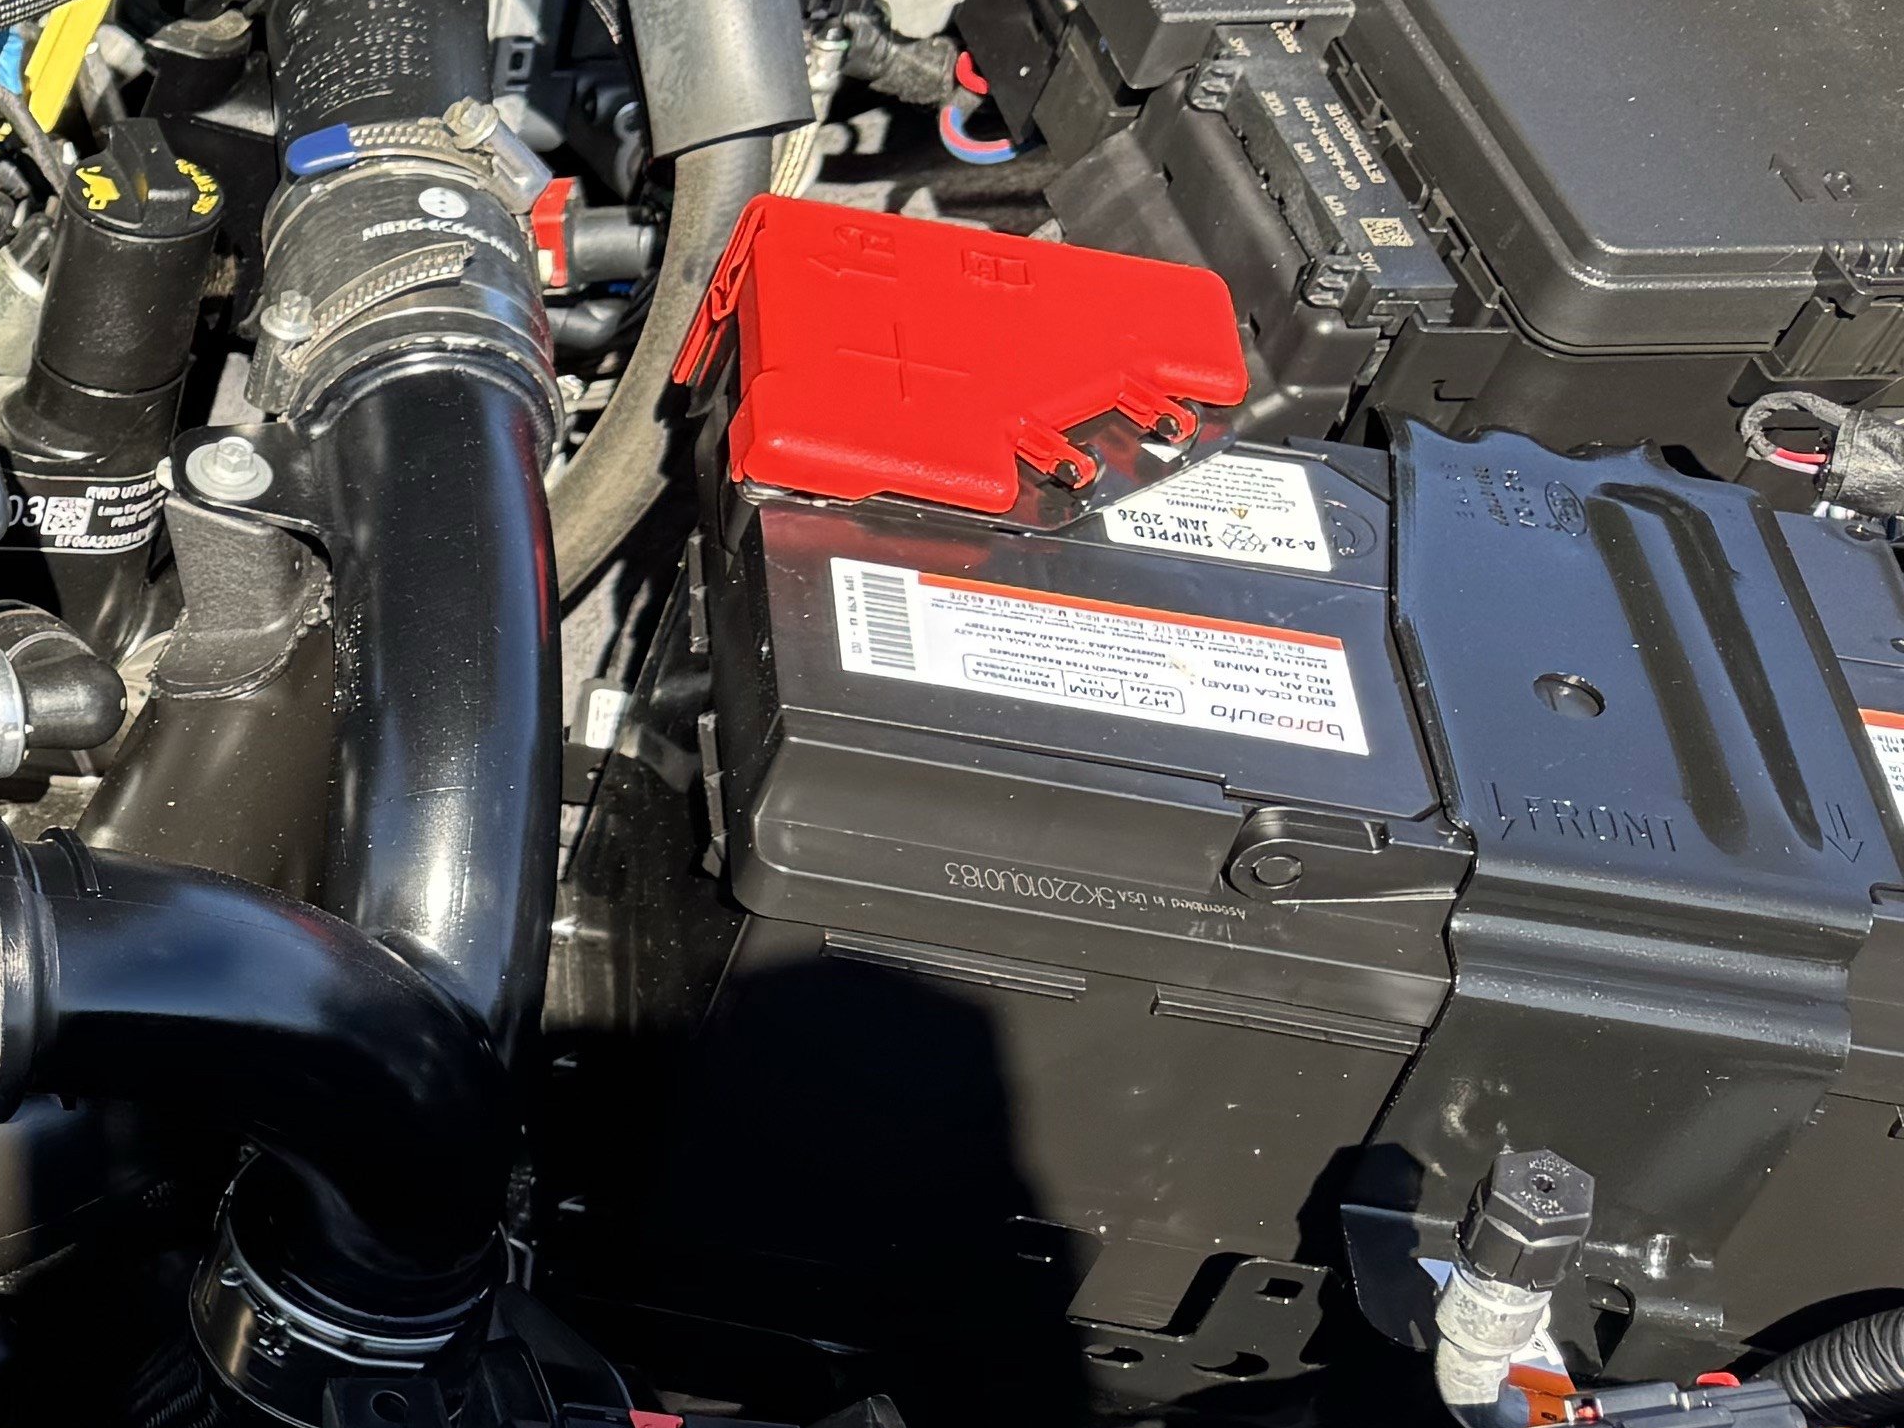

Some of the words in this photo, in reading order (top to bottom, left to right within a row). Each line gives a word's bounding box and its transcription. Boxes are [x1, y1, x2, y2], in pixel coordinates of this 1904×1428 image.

[1117, 508, 1162, 526] 2026
[1169, 515, 1207, 532] JAN.
[1133, 525, 1214, 548] SHIPPED
[1271, 536, 1316, 551] A-26
[1210, 703, 1345, 742] bproauto
[1523, 795, 1676, 853] FRONT
